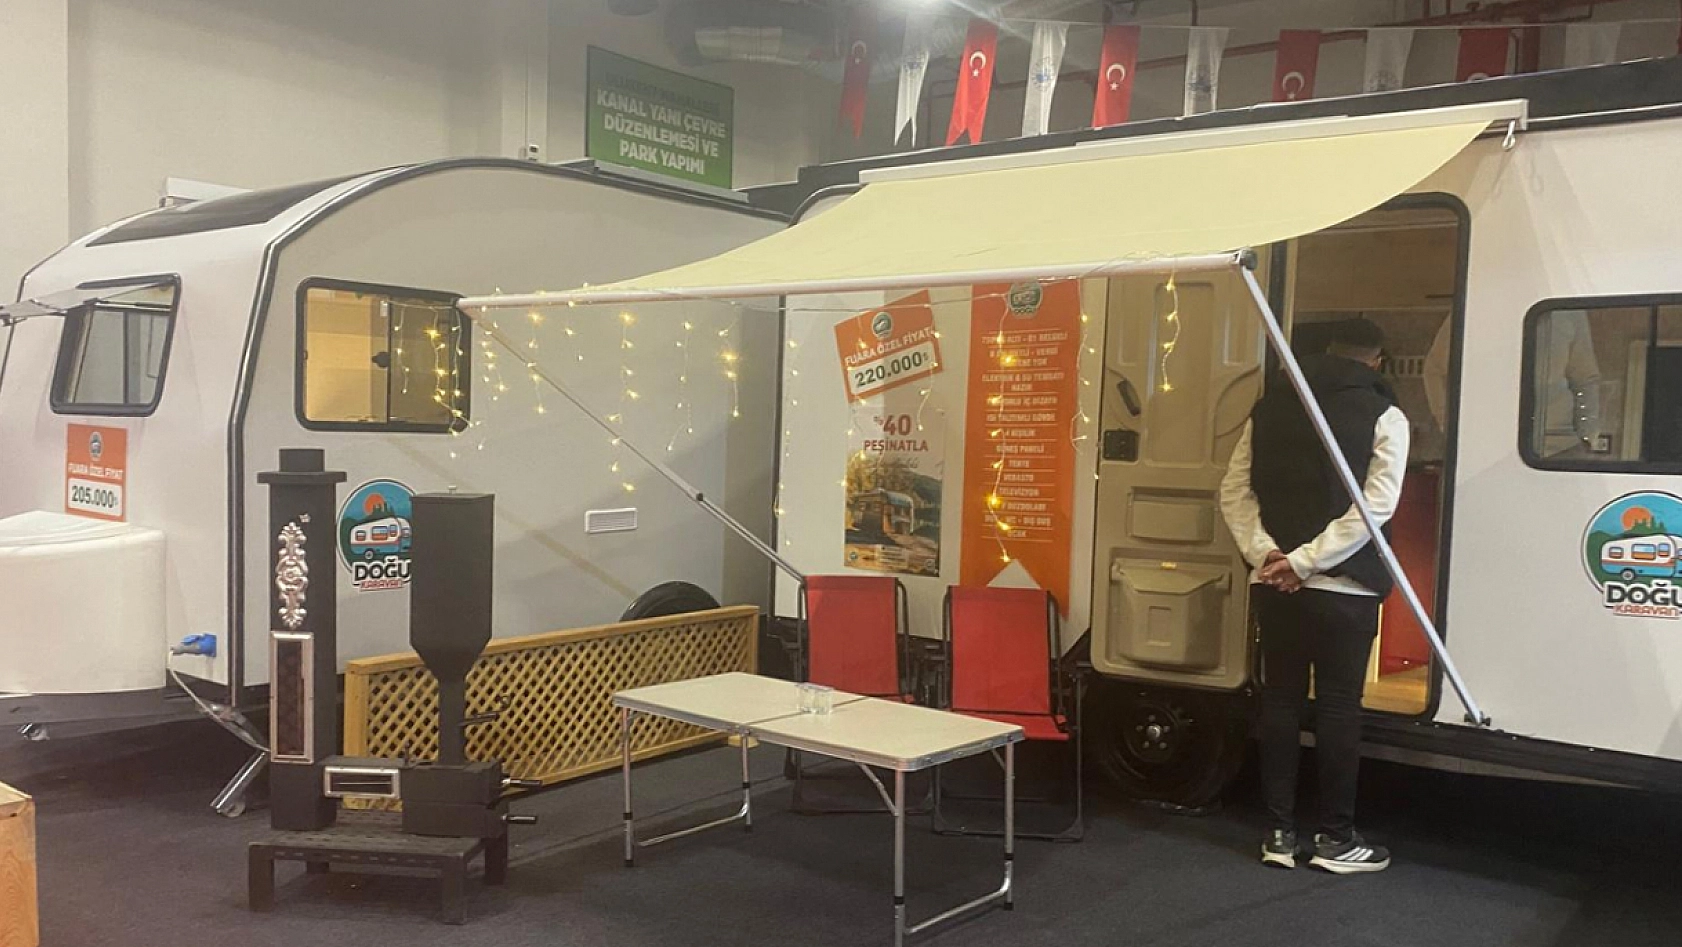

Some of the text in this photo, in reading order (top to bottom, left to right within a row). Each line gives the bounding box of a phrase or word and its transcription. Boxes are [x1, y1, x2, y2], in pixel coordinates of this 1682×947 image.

[597, 89, 646, 117] KANAL
[650, 104, 681, 127] YANI
[684, 113, 725, 138] ÇEVRE
[604, 113, 718, 157] DÜZENLEMESİ VE
[620, 139, 657, 164] PARK
[845, 348, 877, 366] FUARA
[877, 339, 903, 354] ÖZEL
[864, 438, 928, 455] PEŞİNATLA
[354, 556, 411, 580] DOĞU
[1615, 604, 1679, 616] KARAVAN
